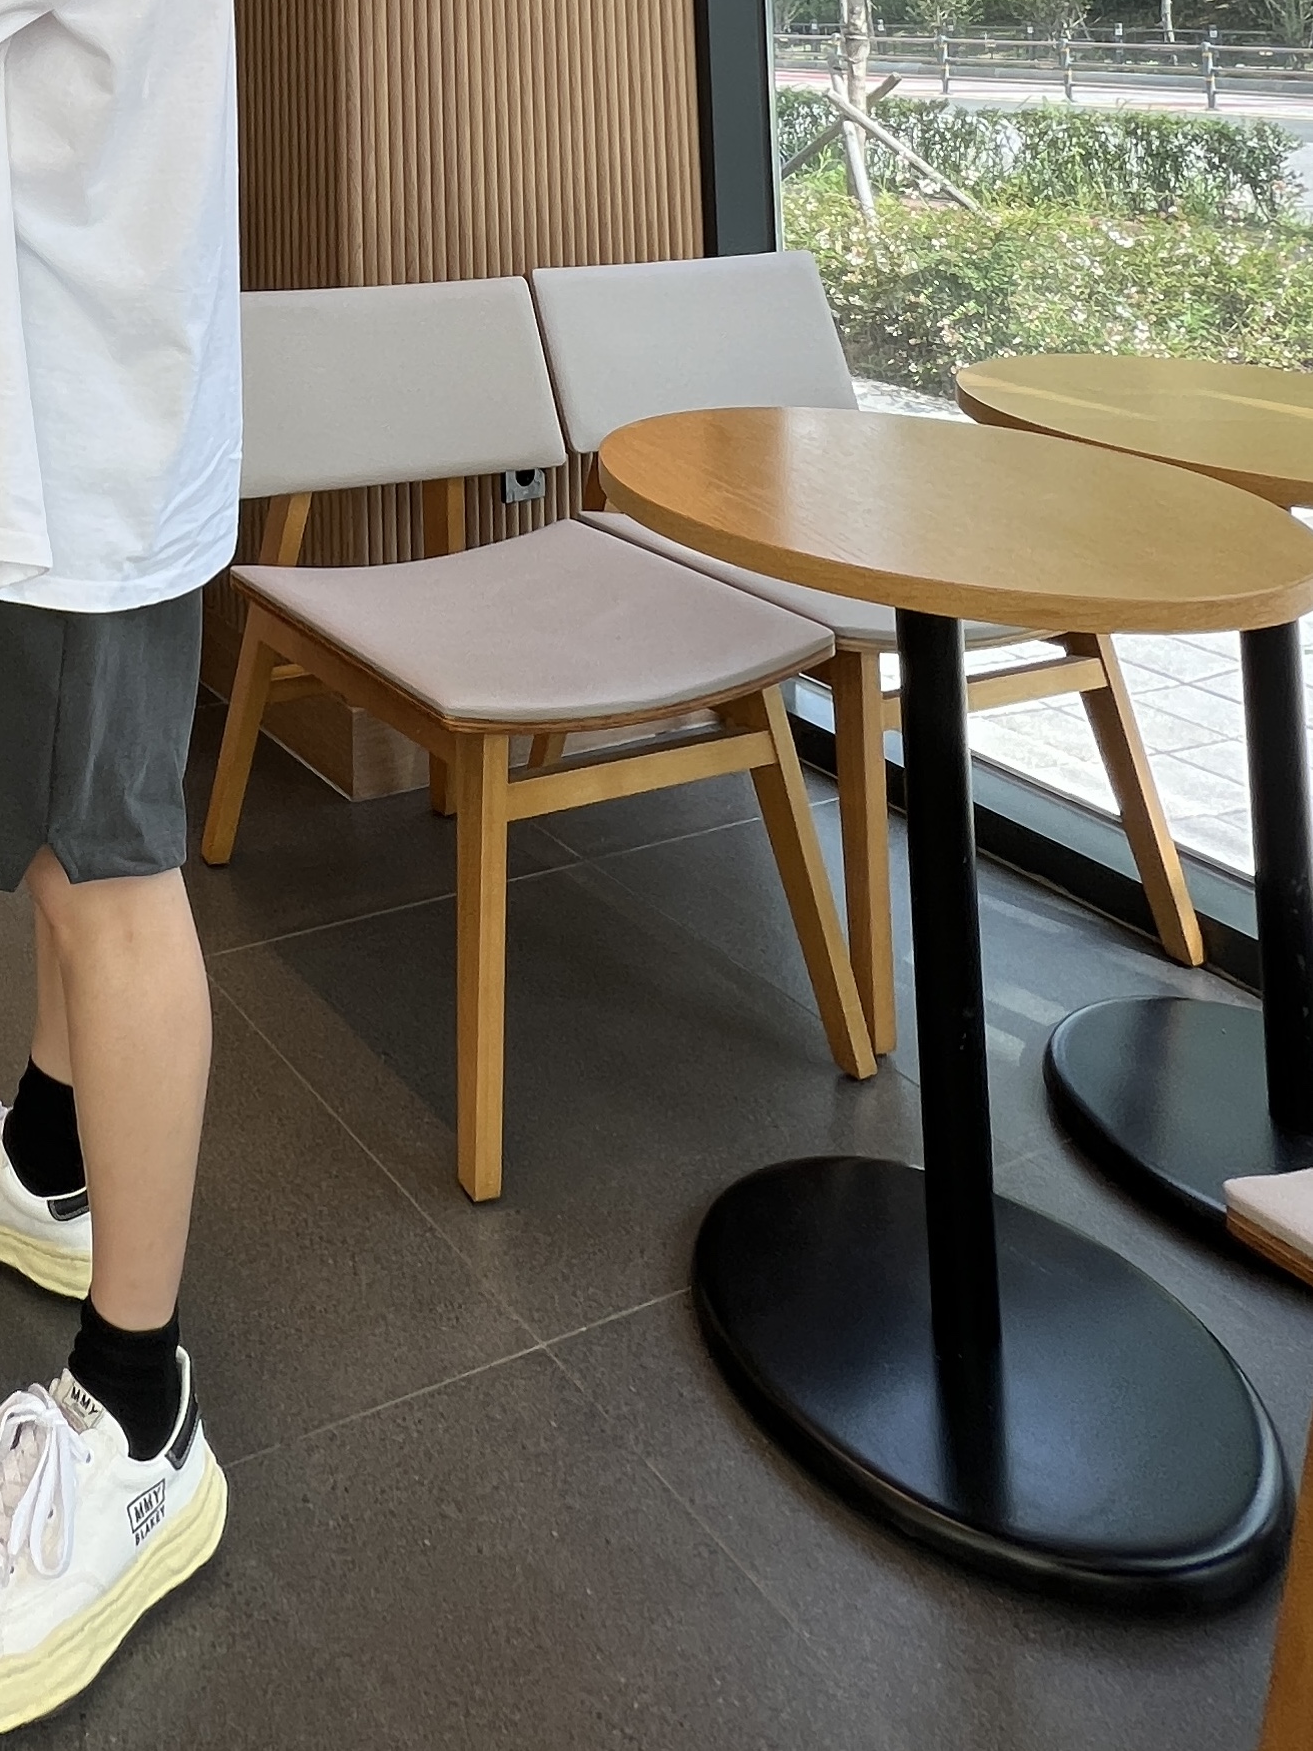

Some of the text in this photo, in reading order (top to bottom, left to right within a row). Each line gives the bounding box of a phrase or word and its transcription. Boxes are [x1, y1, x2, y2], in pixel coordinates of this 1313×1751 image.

[70, 1385, 99, 1415] MMY
[134, 1486, 161, 1523] MMY
[135, 1504, 166, 1546] BLAKEY
